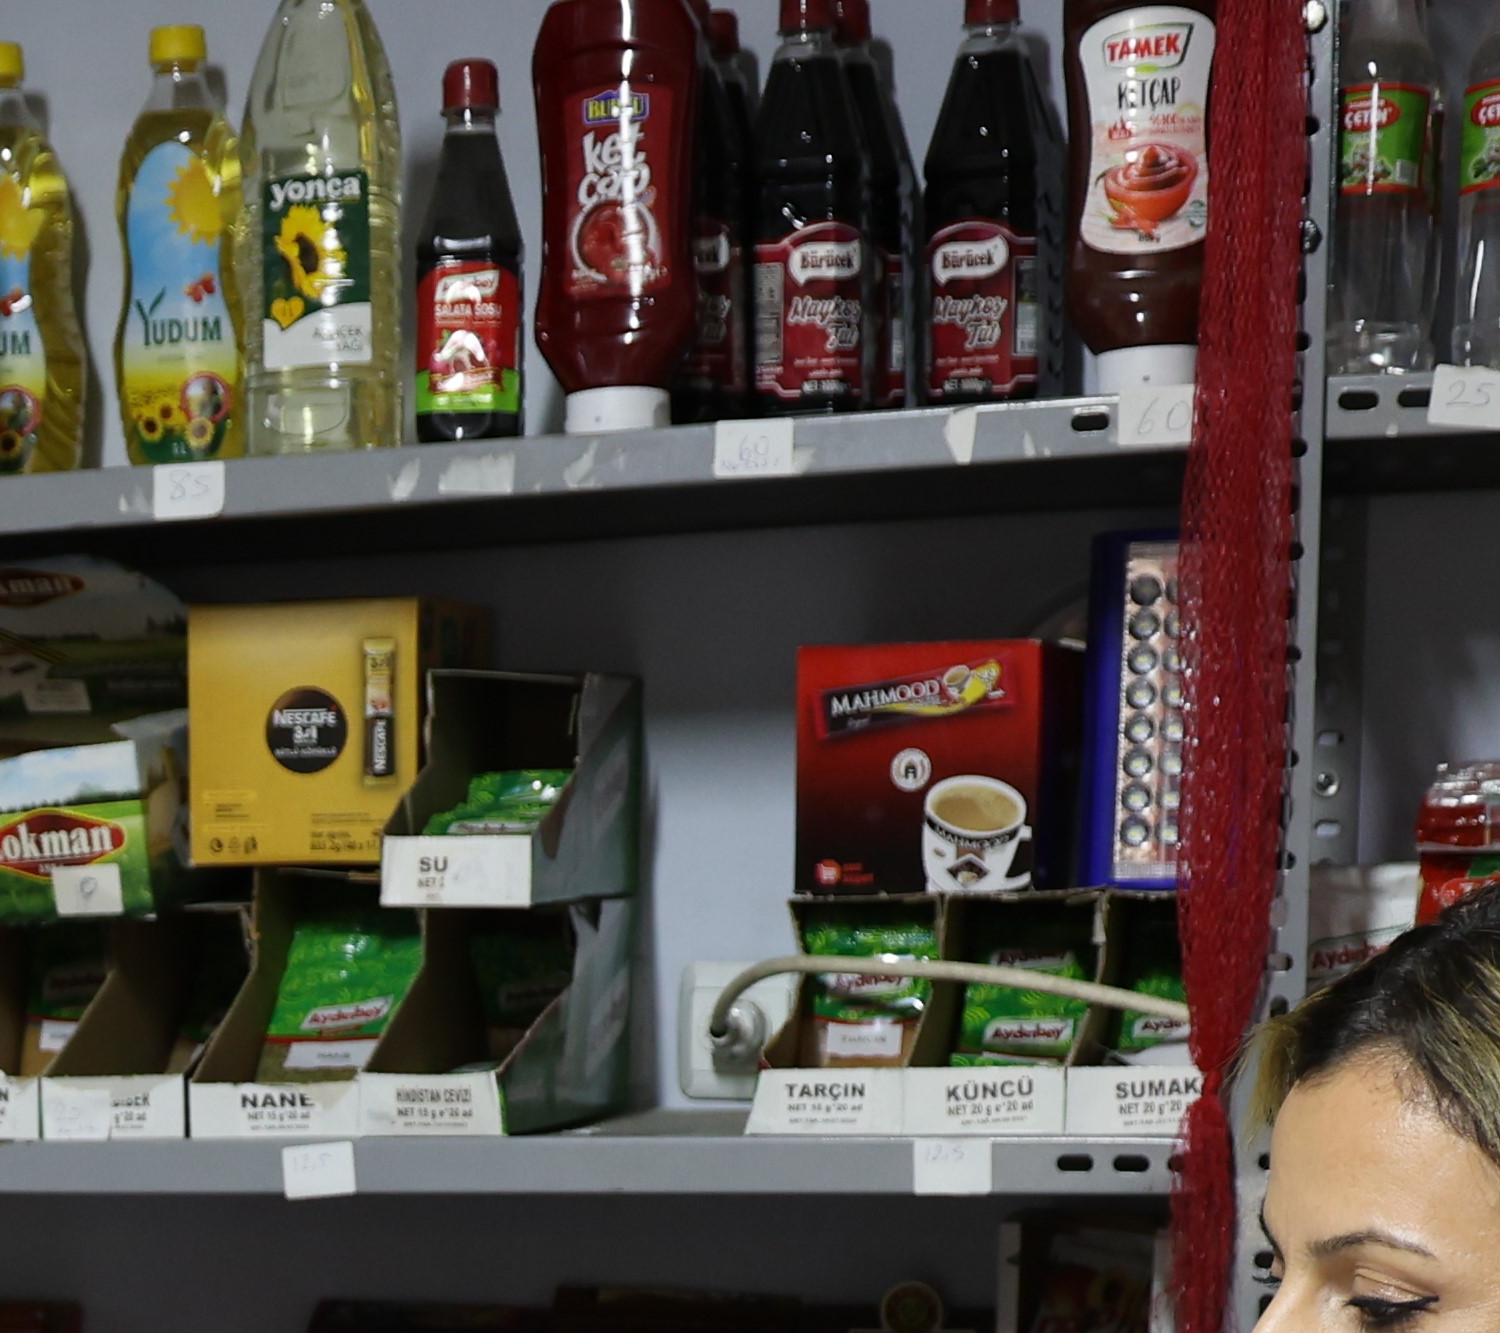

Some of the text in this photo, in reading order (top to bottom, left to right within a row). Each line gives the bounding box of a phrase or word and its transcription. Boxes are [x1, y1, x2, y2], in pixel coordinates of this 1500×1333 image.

[1106, 32, 1181, 63] TAMEK
[1118, 76, 1182, 116] KTÇAP
[270, 177, 362, 209] yonca
[799, 249, 855, 271] Bürücek
[942, 248, 998, 270] Bürücek
[132, 287, 223, 348] YUDUM
[830, 677, 941, 717] MAHMOOD
[240, 1092, 315, 1109] NANE
[945, 1077, 1035, 1102] KÜNCÜ
[1115, 1077, 1202, 1100] SUMAK
